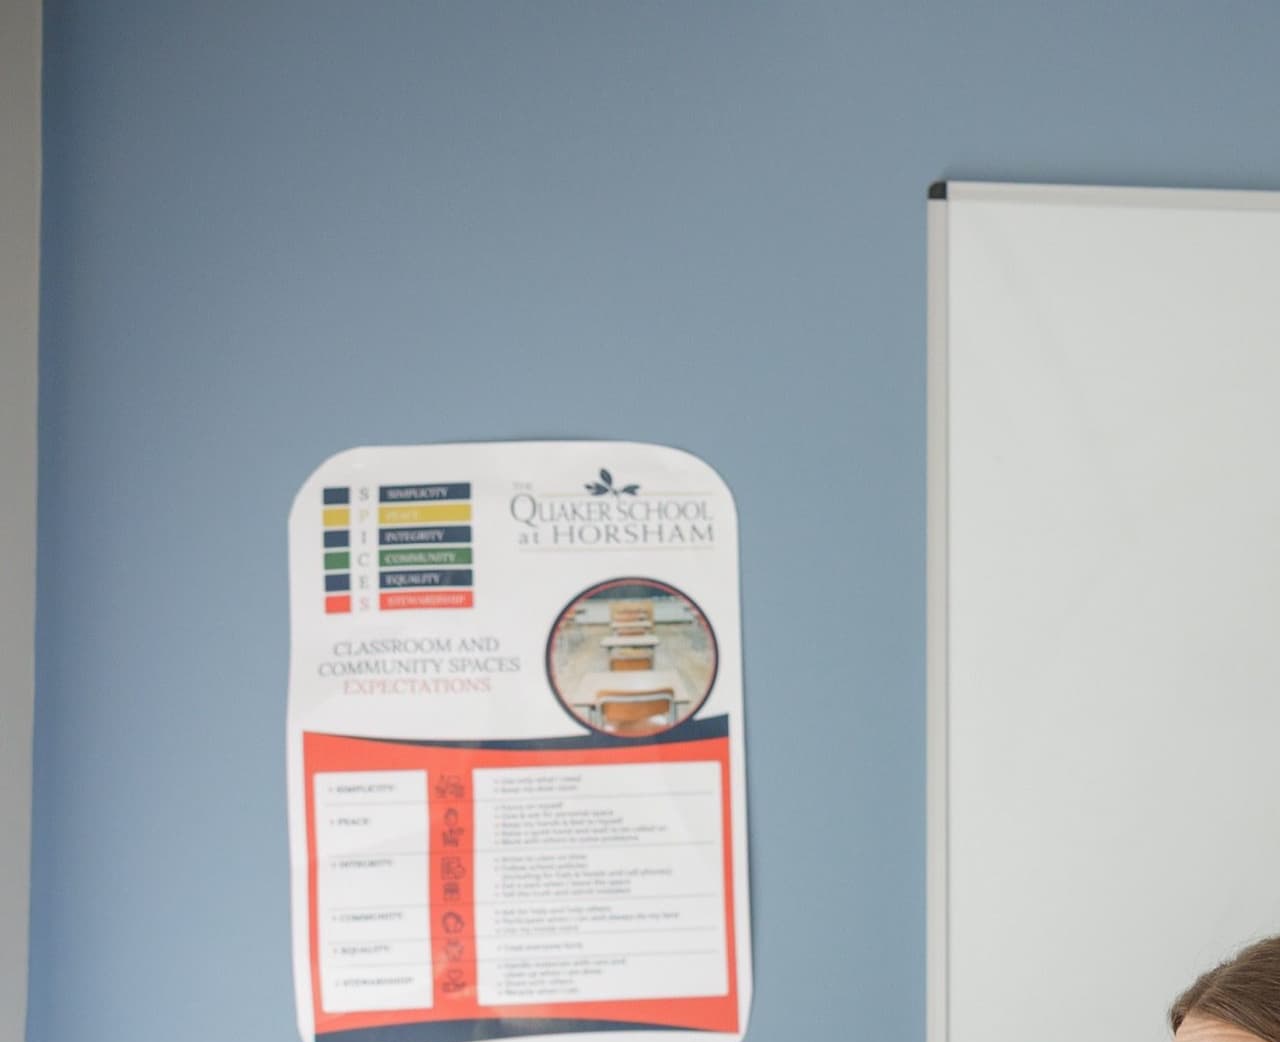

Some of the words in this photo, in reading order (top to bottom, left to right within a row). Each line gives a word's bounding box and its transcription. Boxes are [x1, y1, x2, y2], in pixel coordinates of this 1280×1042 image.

[386, 487, 449, 499] SIMPLICITY
[510, 493, 611, 528] QUAKER
[613, 499, 715, 523] SCHOOL
[384, 529, 445, 542] INTEGRITY
[518, 530, 540, 545] at
[551, 523, 715, 545] HORSHAM
[384, 552, 456, 565] COMMUNITY
[385, 573, 441, 586] EQUALITY
[332, 638, 451, 657] CLASSROOM
[458, 636, 501, 653] AND
[317, 657, 444, 678] COMMUNITY
[447, 655, 522, 674] SPACES
[343, 675, 493, 696] EXPECTATIONS
